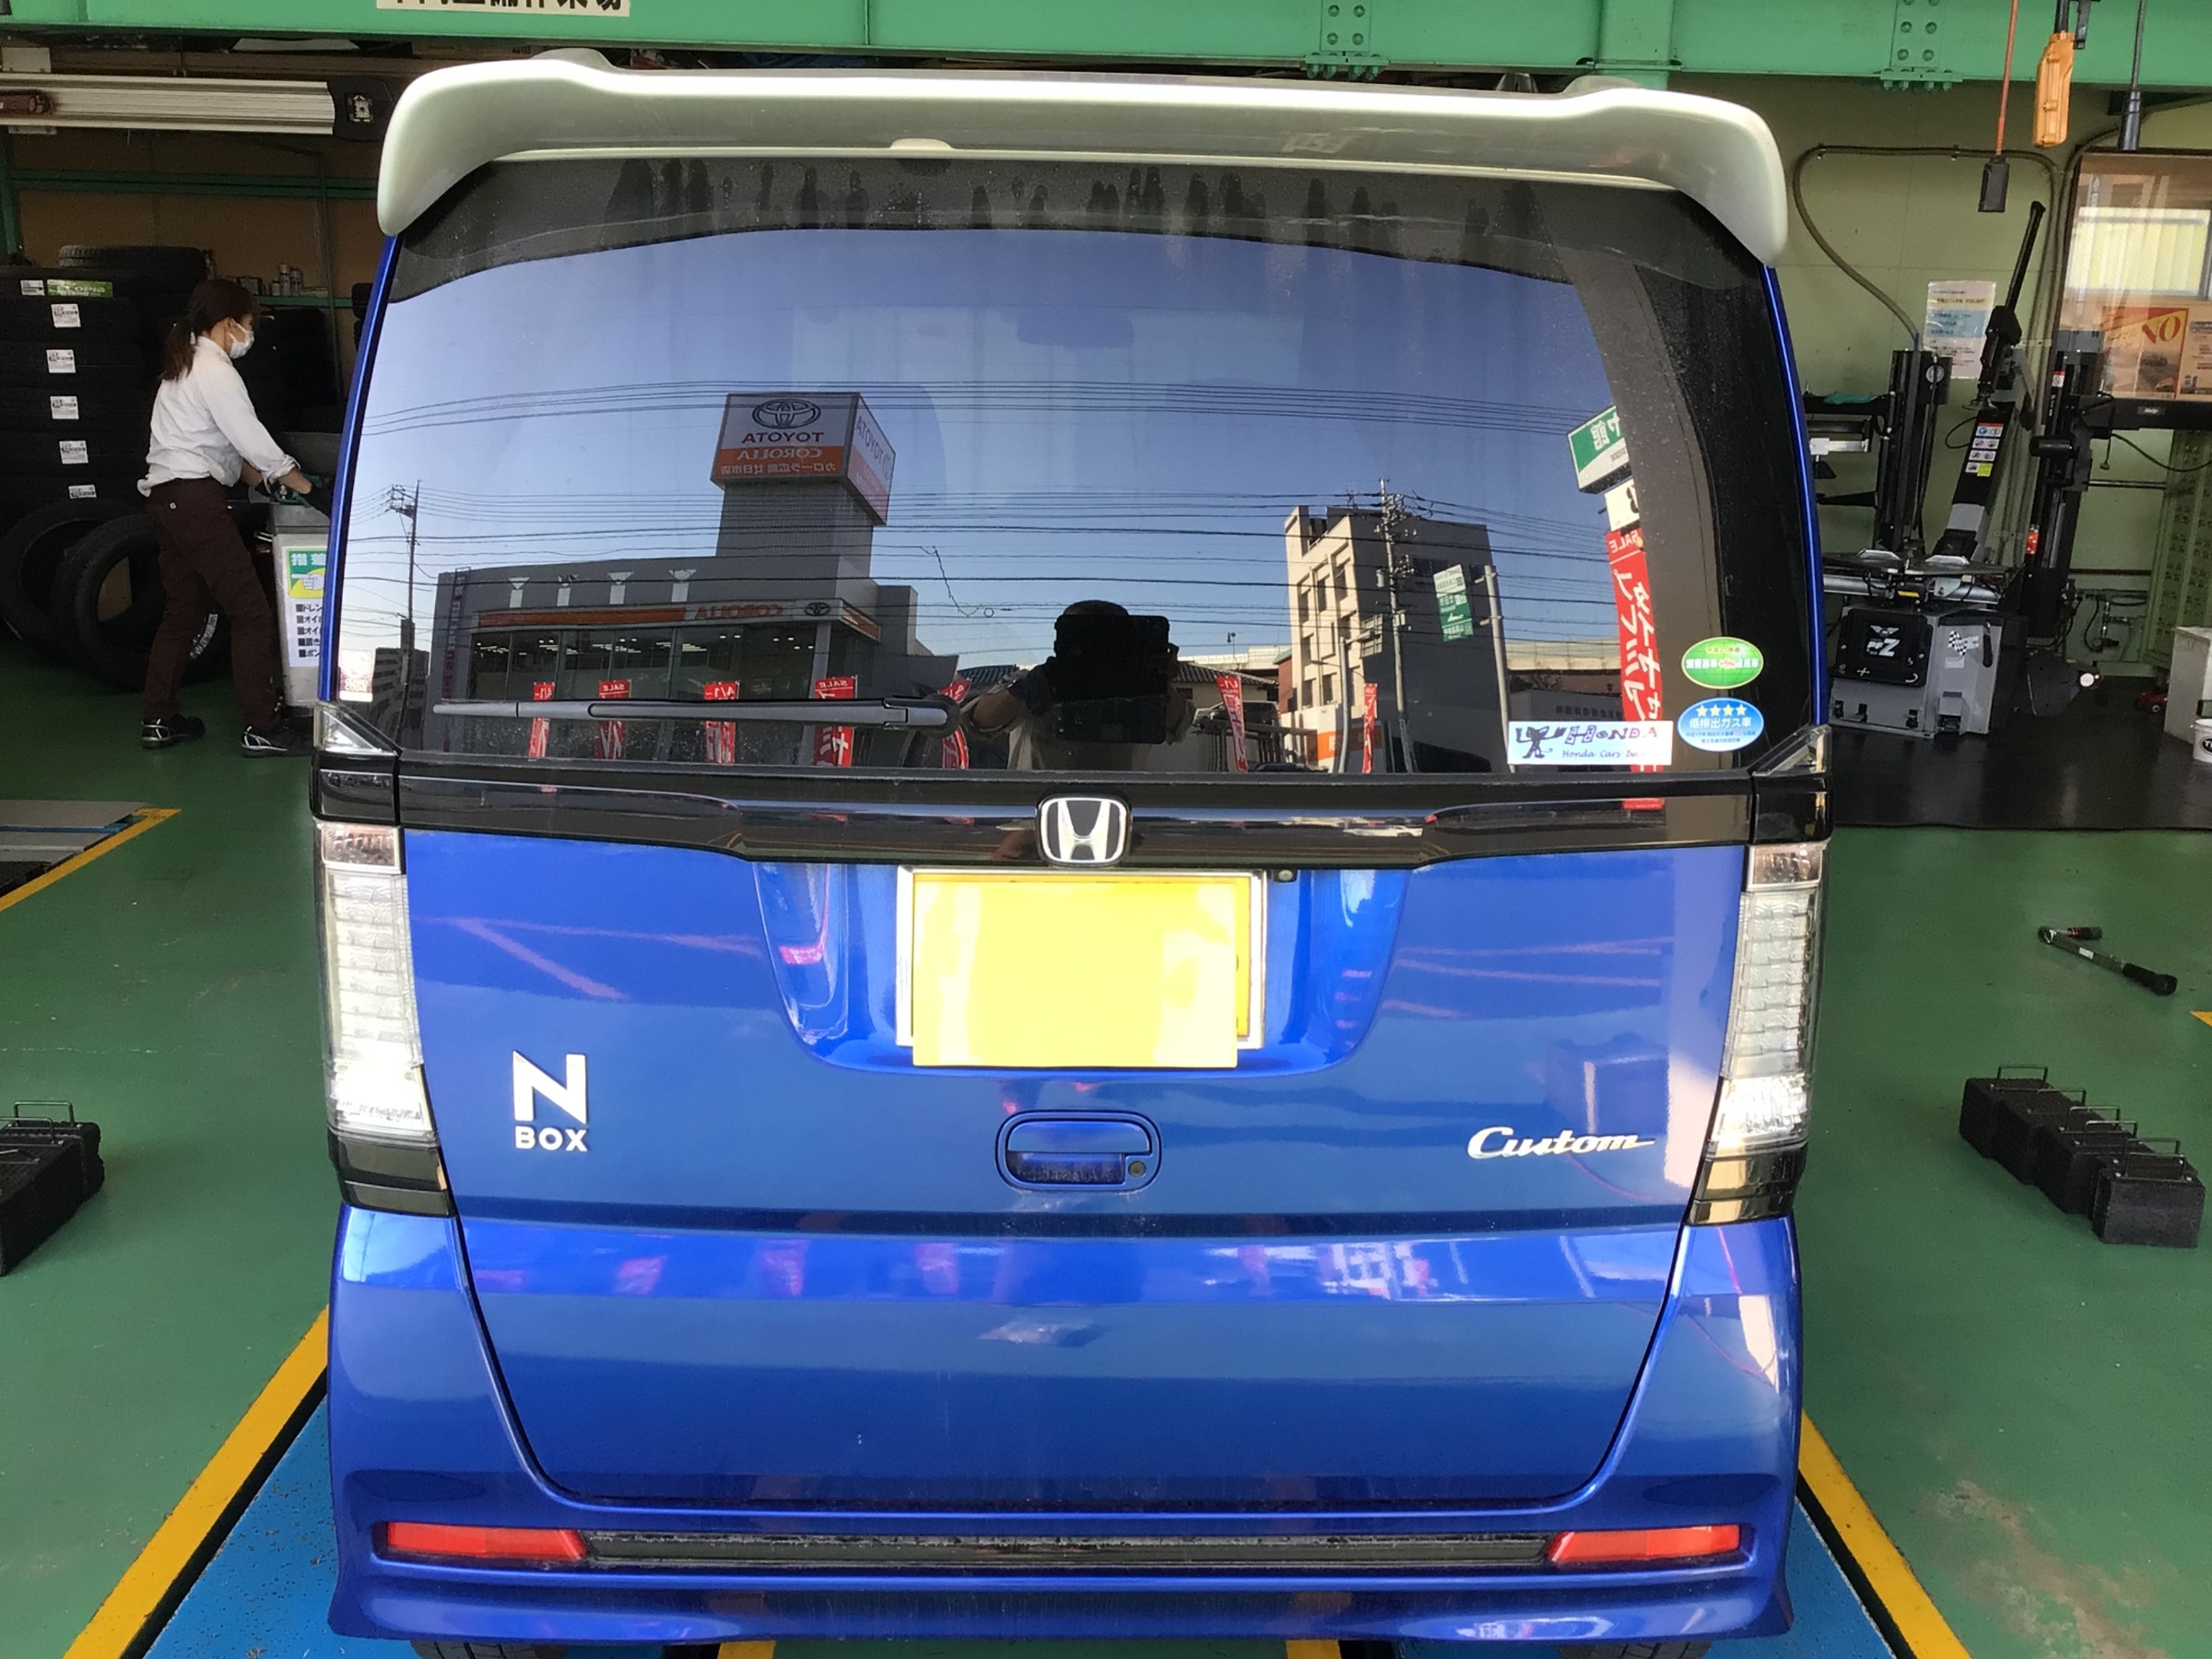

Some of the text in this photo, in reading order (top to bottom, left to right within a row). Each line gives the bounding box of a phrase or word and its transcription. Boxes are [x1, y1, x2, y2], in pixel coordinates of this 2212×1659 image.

[1562, 748, 1595, 759] Honda
[1599, 749, 1621, 759] Cars
[512, 1050, 587, 1125] N
[514, 1125, 588, 1152] BOX
[1467, 1126, 1656, 1159] Custom
